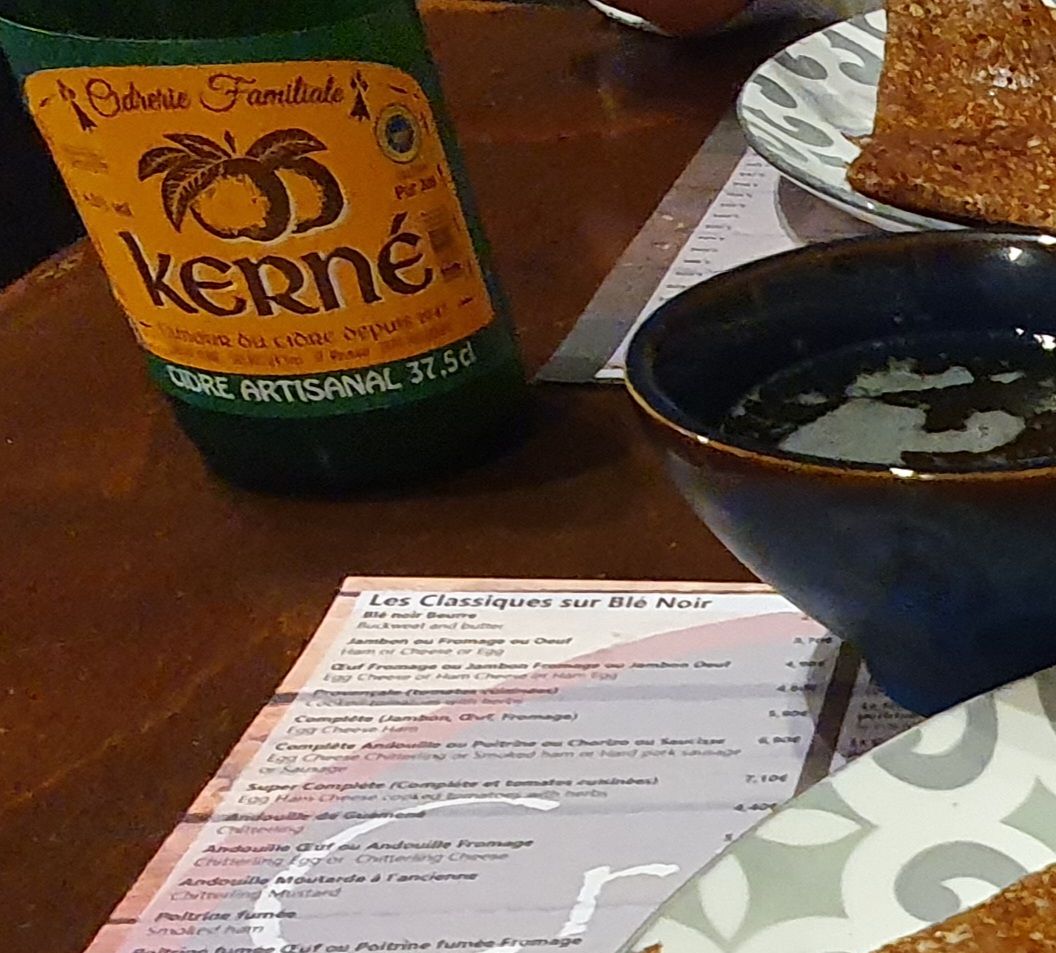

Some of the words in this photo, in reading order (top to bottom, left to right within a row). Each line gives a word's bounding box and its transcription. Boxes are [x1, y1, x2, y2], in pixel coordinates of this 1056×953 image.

[200, 73, 346, 112] Familiale
[165, 364, 235, 400] CIDRE
[240, 366, 402, 402] ARTISANAL
[369, 594, 412, 607] Les
[419, 594, 553, 610] Classiques
[560, 597, 602, 608] sur
[608, 596, 647, 608] Blé
[655, 596, 713, 609] Noir
[347, 637, 408, 646] Jambon
[437, 637, 508, 647] Fromage
[367, 663, 438, 672] Fromage
[465, 663, 528, 671] Jambon
[247, 782, 299, 793] Super
[203, 843, 291, 854] Andouille
[365, 839, 451, 851] Andouille
[456, 838, 534, 850] Fromage
[178, 875, 269, 887] Andouille
[355, 939, 431, 952] Poitrine
[500, 935, 583, 949] Fromage
